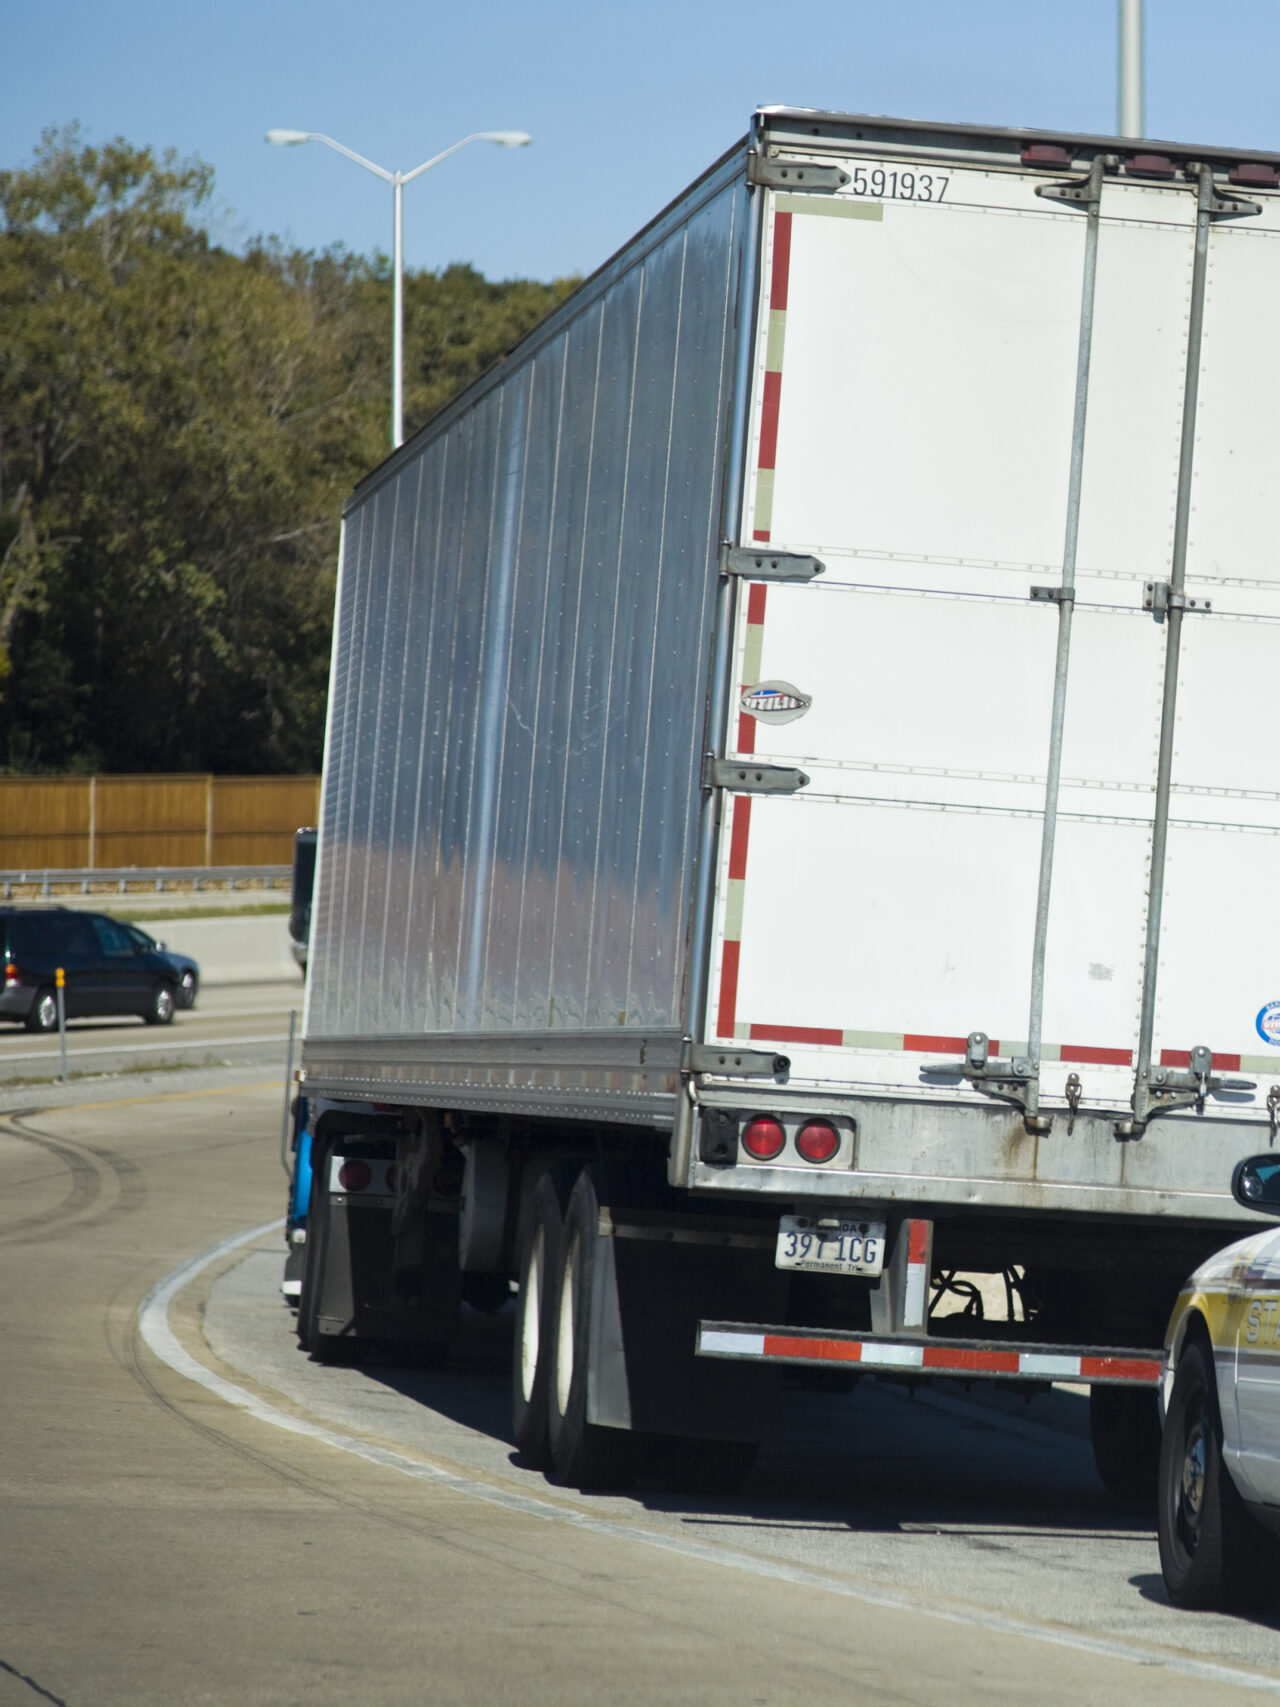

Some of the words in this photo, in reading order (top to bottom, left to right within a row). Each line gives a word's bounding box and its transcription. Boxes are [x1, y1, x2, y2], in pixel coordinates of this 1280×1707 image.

[853, 167, 950, 203] 591937
[835, 1235, 877, 1264] 1CG
[800, 1259, 843, 1271] Permanent
